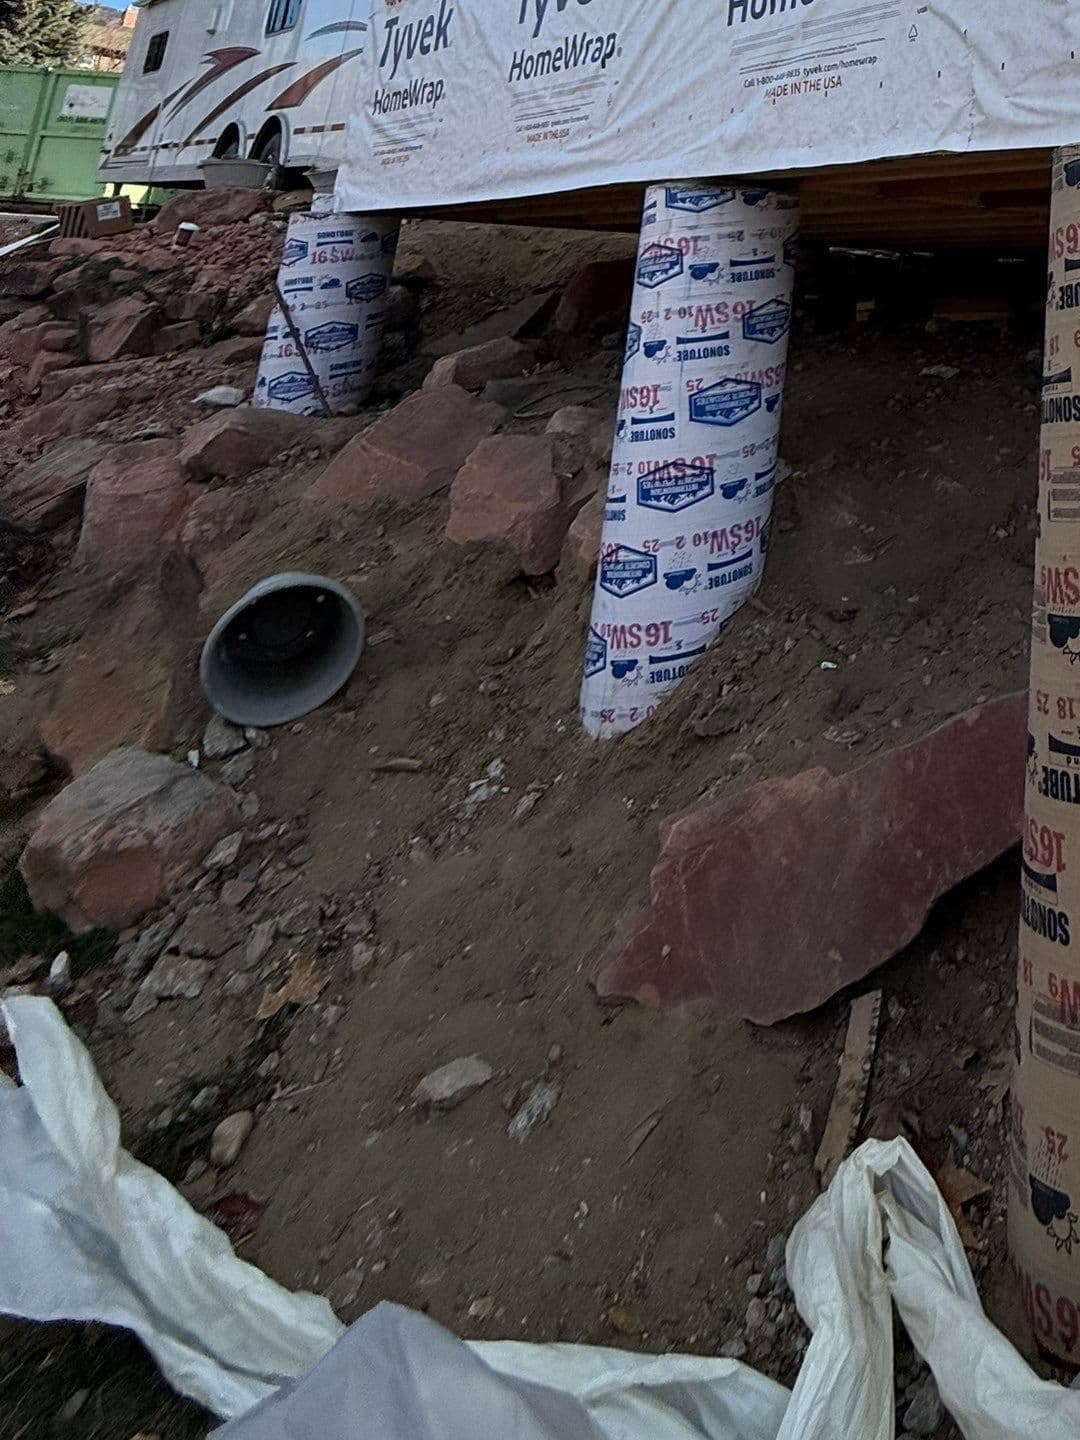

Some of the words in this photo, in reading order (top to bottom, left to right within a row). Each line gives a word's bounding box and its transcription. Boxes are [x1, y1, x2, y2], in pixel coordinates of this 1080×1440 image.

[508, 32, 618, 83] HomeWrap
[790, 81, 801, 94] IN
[803, 78, 822, 94] THE
[824, 75, 843, 89] USA
[372, 78, 444, 116] HomeWrap
[730, 268, 775, 284] SONOTUBE
[676, 344, 730, 362] SONOTUBE
[685, 378, 704, 392] 25
[631, 426, 676, 443] SONOTUBE
[643, 539, 661, 554] 25
[675, 536, 685, 549] 2
[708, 561, 753, 590] SONOTUBE
[700, 607, 720, 626] 25
[1036, 689, 1050, 715] 25
[1056, 697, 1076, 720] 18
[601, 708, 616, 724] 25
